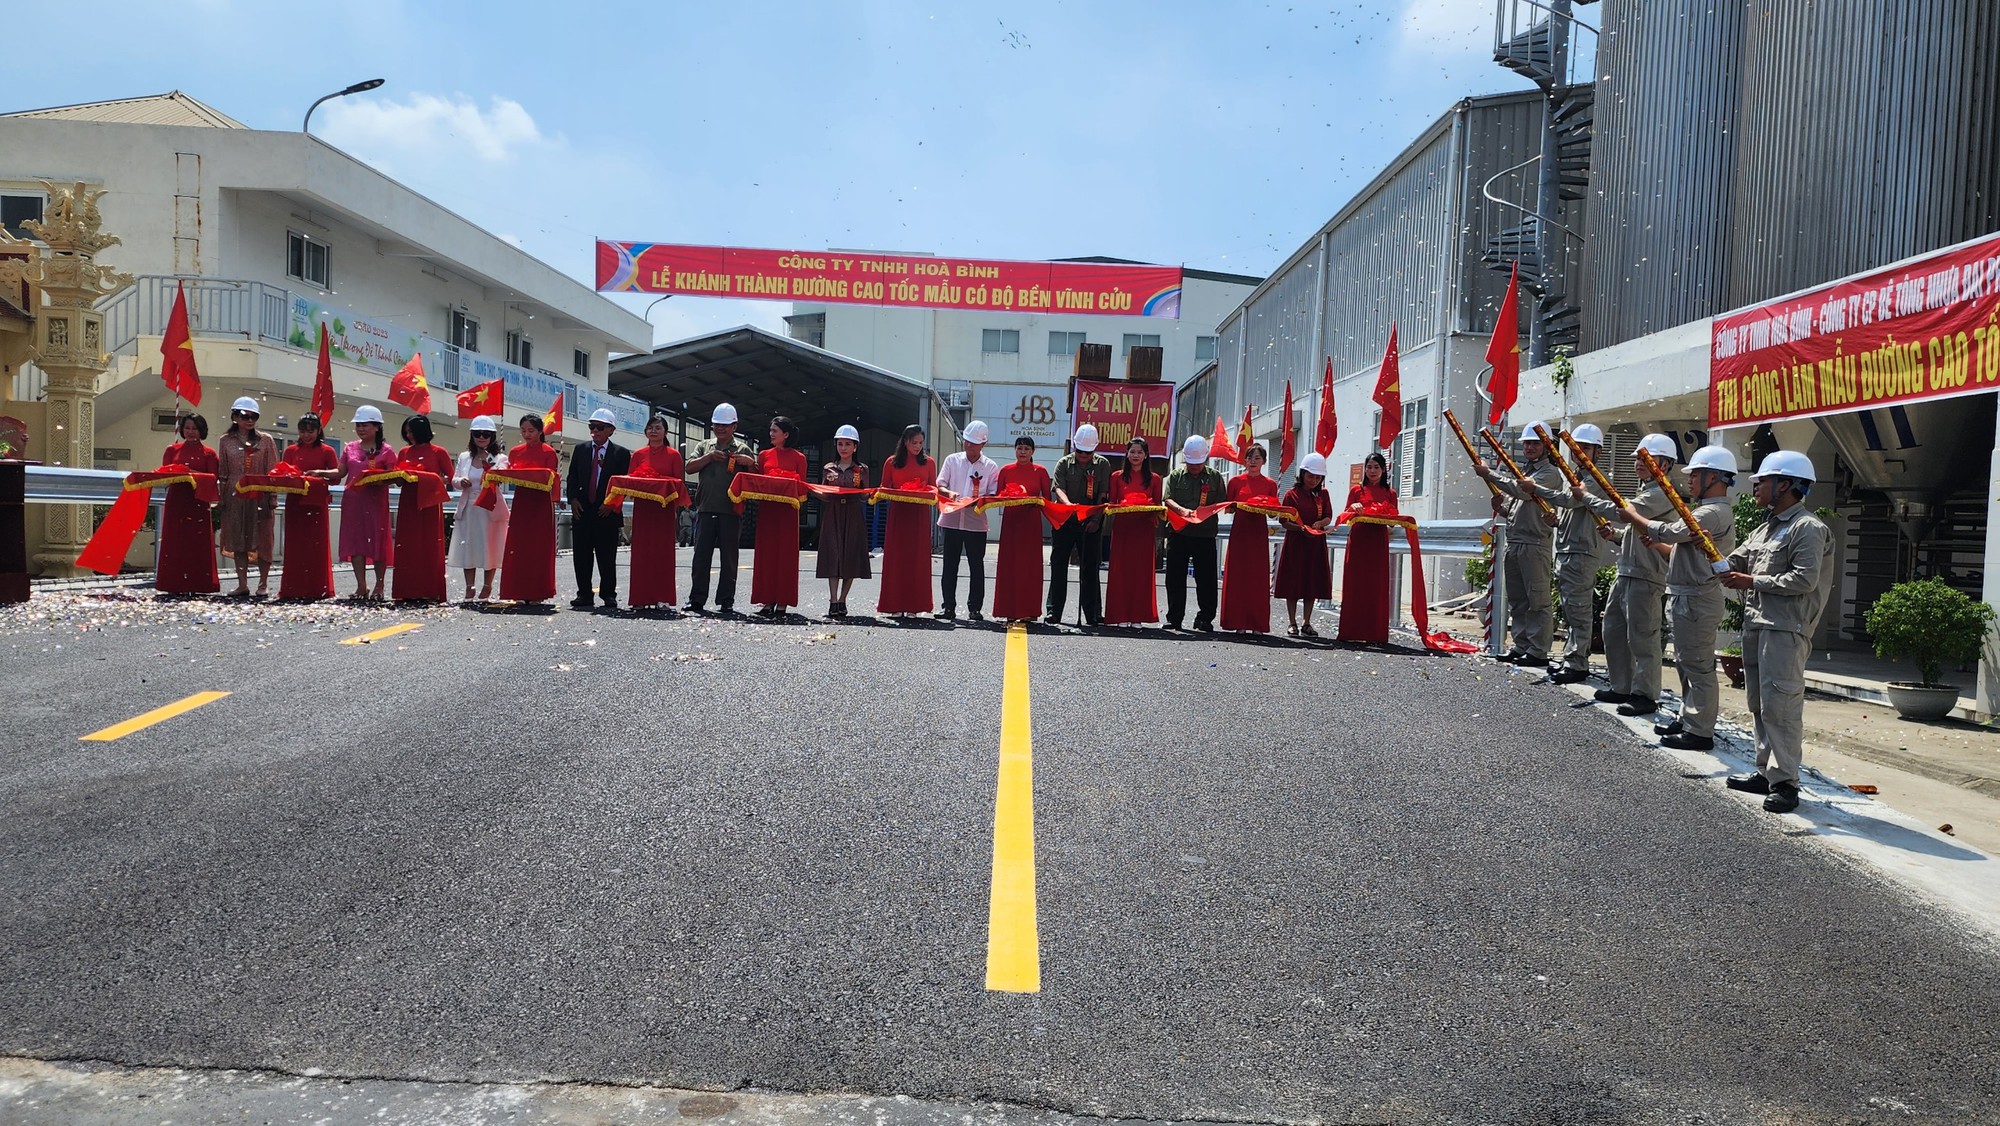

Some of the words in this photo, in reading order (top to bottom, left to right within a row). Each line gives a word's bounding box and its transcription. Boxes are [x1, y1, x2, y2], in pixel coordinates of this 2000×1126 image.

[778, 254, 826, 270] CÔNG
[831, 258, 854, 271] TY
[860, 260, 908, 274] TNHH
[914, 261, 950, 276] HOÀ
[956, 262, 999, 278] BÌNH
[652, 265, 670, 289] LỄ
[675, 269, 730, 292] KHÁNH
[735, 272, 788, 295] THÀNH
[793, 274, 848, 298] ĐƯỜNG
[853, 280, 884, 300] CAO
[889, 277, 919, 300] TỐC
[924, 279, 960, 304] MẪU
[966, 283, 988, 305] CÓ
[992, 285, 1013, 310] ĐỘ
[1018, 284, 1050, 308] BỀN
[1056, 288, 1094, 310] VĨNH
[1099, 287, 1132, 310] CỬU
[1716, 325, 1737, 360] CÔNG
[1739, 324, 1750, 354] TY
[1750, 318, 1772, 352] TNHH
[1790, 304, 1813, 342] BÌNH
[1819, 295, 1846, 336] CÔNG
[1848, 293, 1862, 328] TY
[1862, 290, 1877, 326] CP
[1878, 278, 1894, 322] BÊ
[1896, 274, 1925, 318] TÔNG
[1926, 264, 1960, 314] NHỰA
[1962, 260, 1984, 308] ĐẠI
[1717, 378, 1738, 422] THI
[1742, 364, 1782, 418] CÔNG
[1782, 356, 1817, 412] LÀM
[1818, 338, 1858, 406] MẪU
[1860, 334, 1924, 401] ĐƯỜNG
[1928, 331, 1970, 392] CAO
[1080, 392, 1098, 412] 42
[1103, 387, 1134, 414] TẤN
[1098, 422, 1132, 450] TRỌNG
